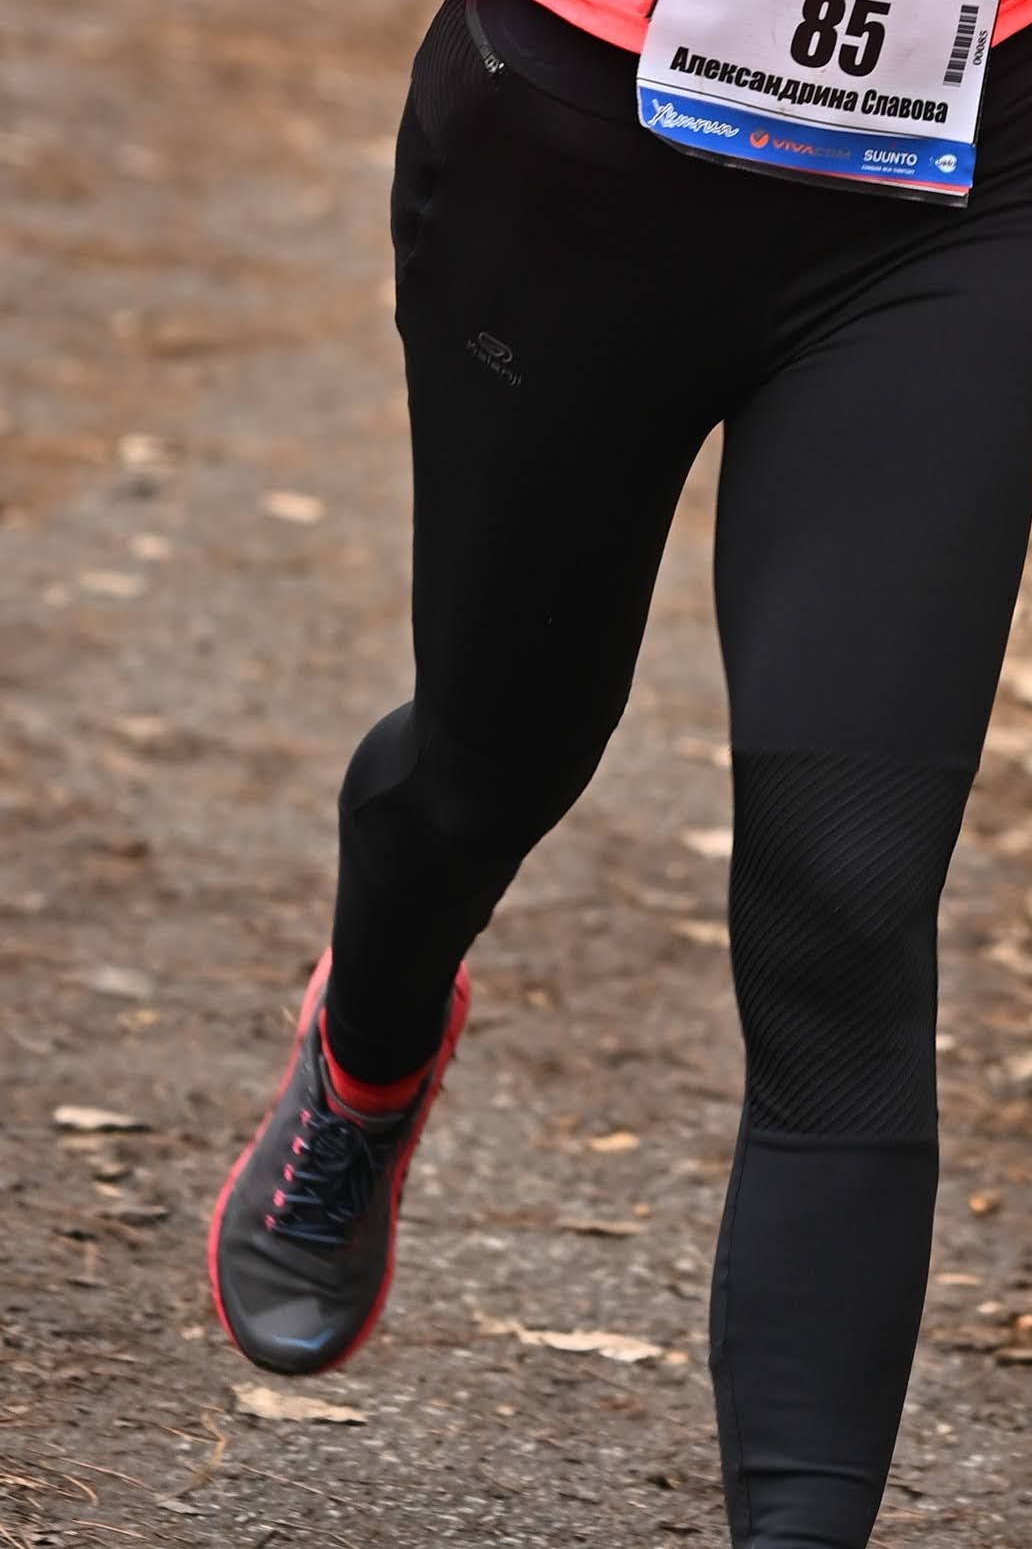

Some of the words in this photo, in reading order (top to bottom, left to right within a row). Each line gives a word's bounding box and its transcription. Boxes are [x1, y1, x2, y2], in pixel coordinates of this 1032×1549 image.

[973, 30, 988, 66] 00085
[669, 46, 859, 111] Александрина
[861, 88, 949, 124] Славова
[863, 149, 918, 167] SUUNTO
